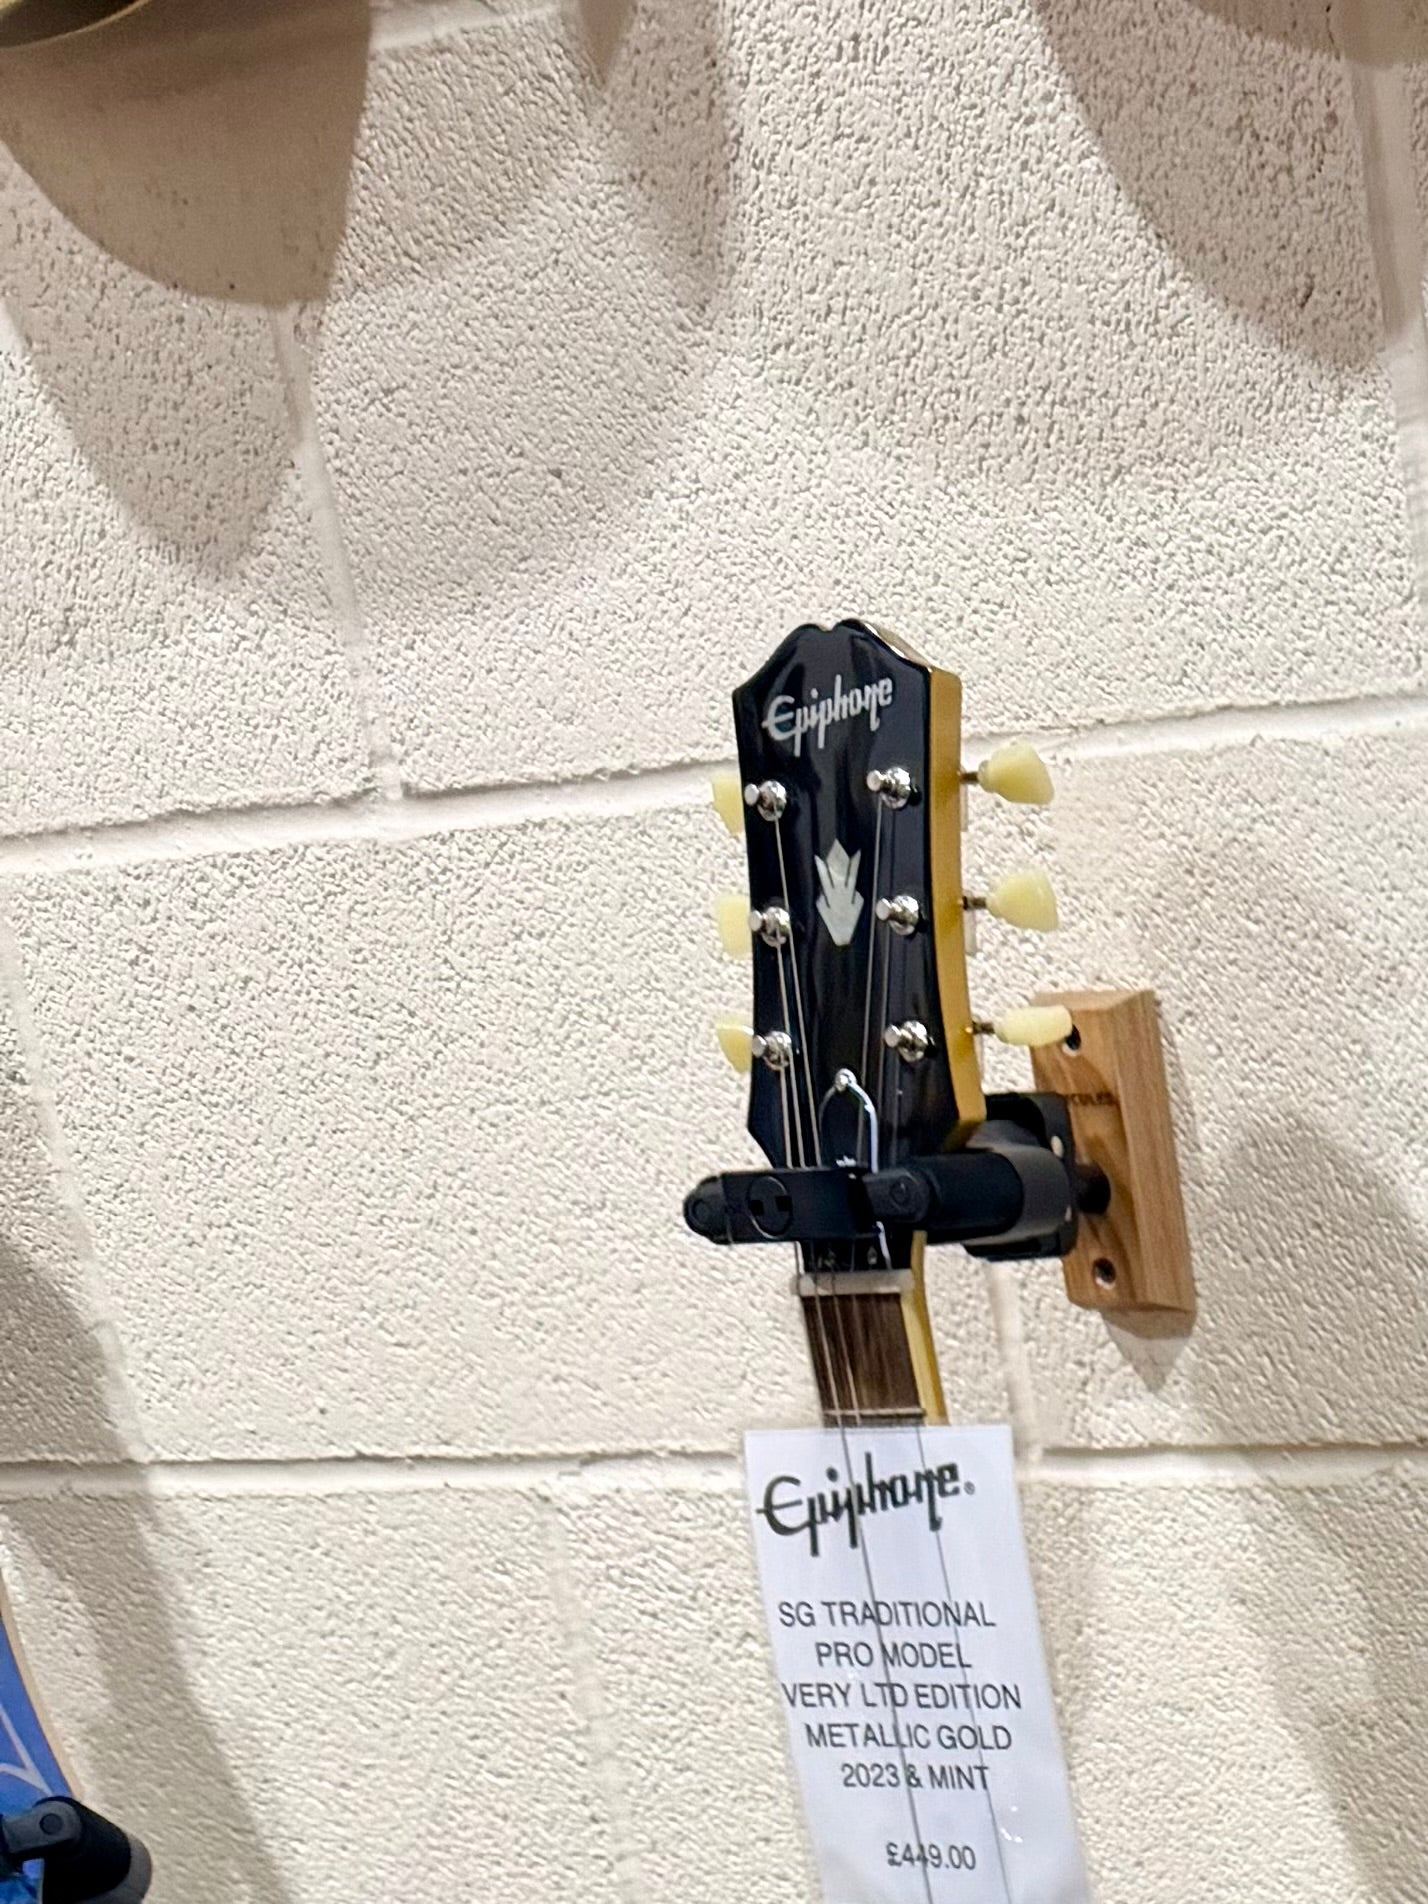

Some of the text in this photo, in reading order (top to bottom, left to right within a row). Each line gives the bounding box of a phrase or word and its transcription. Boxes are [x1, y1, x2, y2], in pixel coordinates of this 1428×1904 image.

[761, 674, 893, 756] Epiphone
[757, 1452, 961, 1557] Epiphone
[778, 1602, 996, 1628] SG TRADITIONAL
[817, 1643, 973, 1669] PRO MODEL
[782, 1683, 1022, 1710] VERY LTD EDITION
[805, 1723, 1013, 1750] METALLIC GOLD
[842, 1764, 989, 1790] 2023 & MINT
[887, 1844, 976, 1871] £449.00
